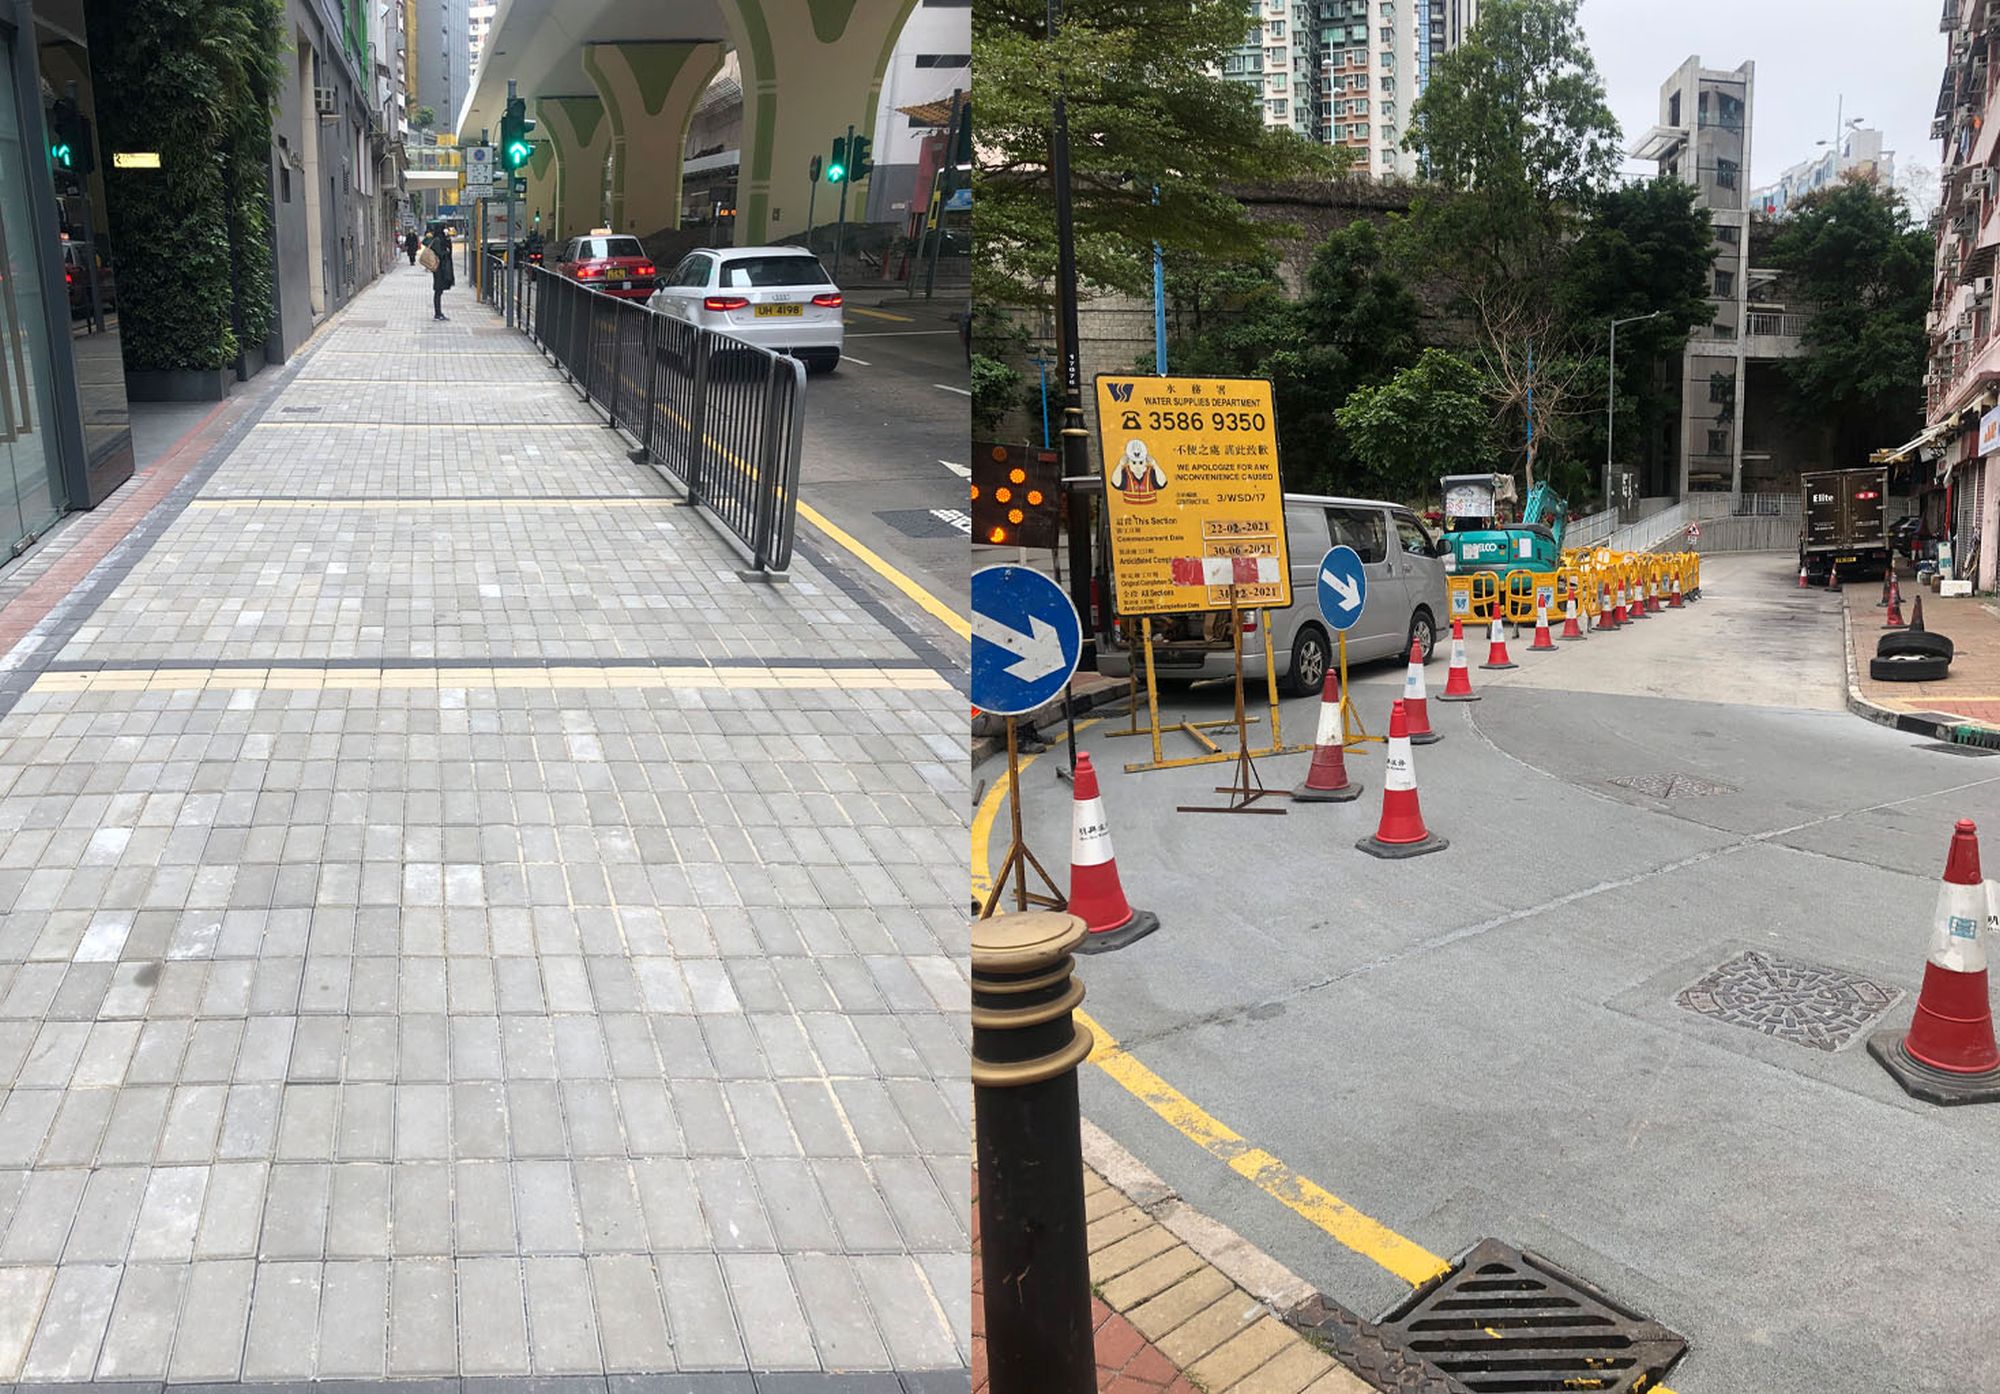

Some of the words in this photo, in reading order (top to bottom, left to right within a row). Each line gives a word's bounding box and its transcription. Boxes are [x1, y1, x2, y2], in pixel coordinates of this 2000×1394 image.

[759, 307, 772, 315] UH
[777, 305, 799, 314] 4198
[1144, 397, 1171, 405] WATER
[1174, 398, 1210, 406] SUPPLIES
[1212, 398, 1261, 407] DEPARTMENT
[1149, 412, 1203, 430] 3586
[1212, 413, 1265, 431] 9350
[1217, 494, 1265, 502] 3/WSD/17
[1813, 493, 1834, 502] Elite
[1135, 517, 1149, 525] This
[1151, 517, 1177, 525] Section
